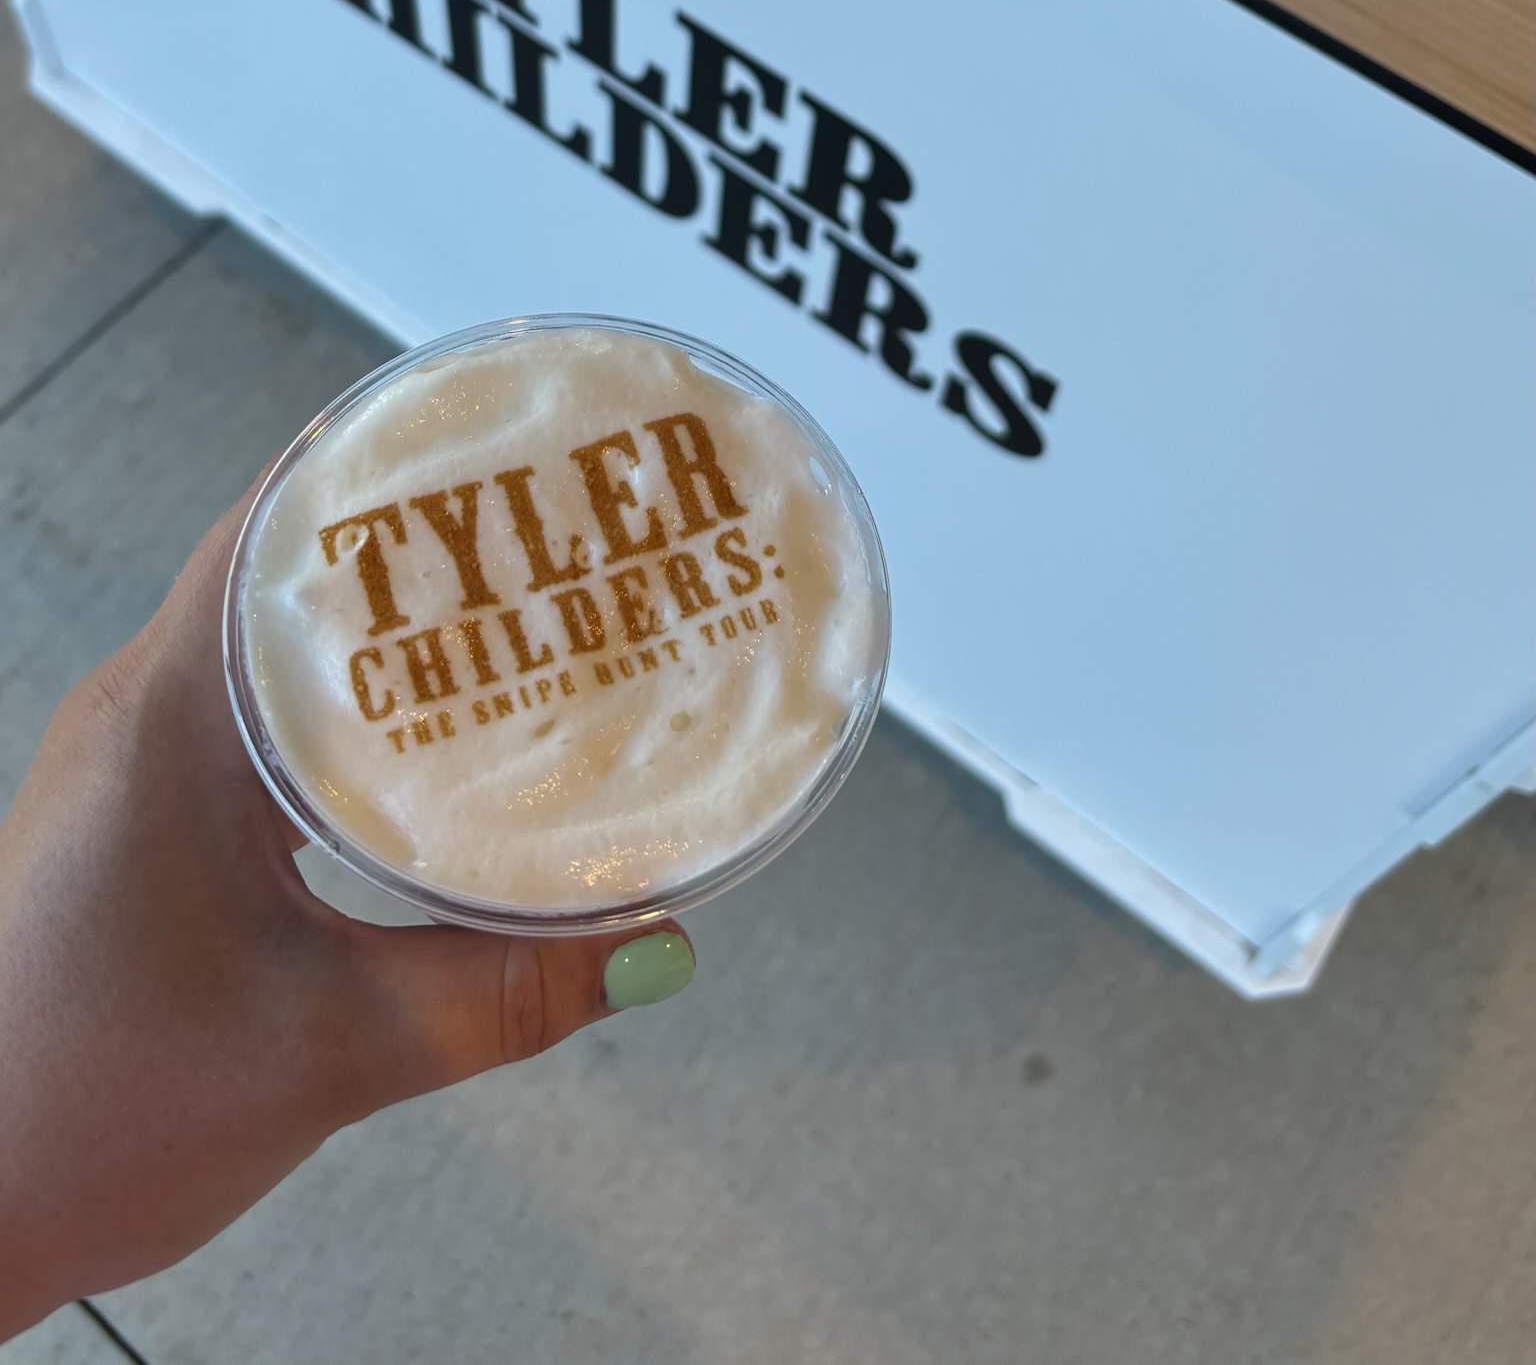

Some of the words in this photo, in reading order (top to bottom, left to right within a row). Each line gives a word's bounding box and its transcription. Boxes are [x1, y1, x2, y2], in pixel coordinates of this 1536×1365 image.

[319, 413, 748, 638] TYLER
[387, 712, 456, 753] THE
[471, 671, 577, 725] SNIPE
[593, 639, 682, 687] HUNT
[700, 599, 781, 647] TOUR
